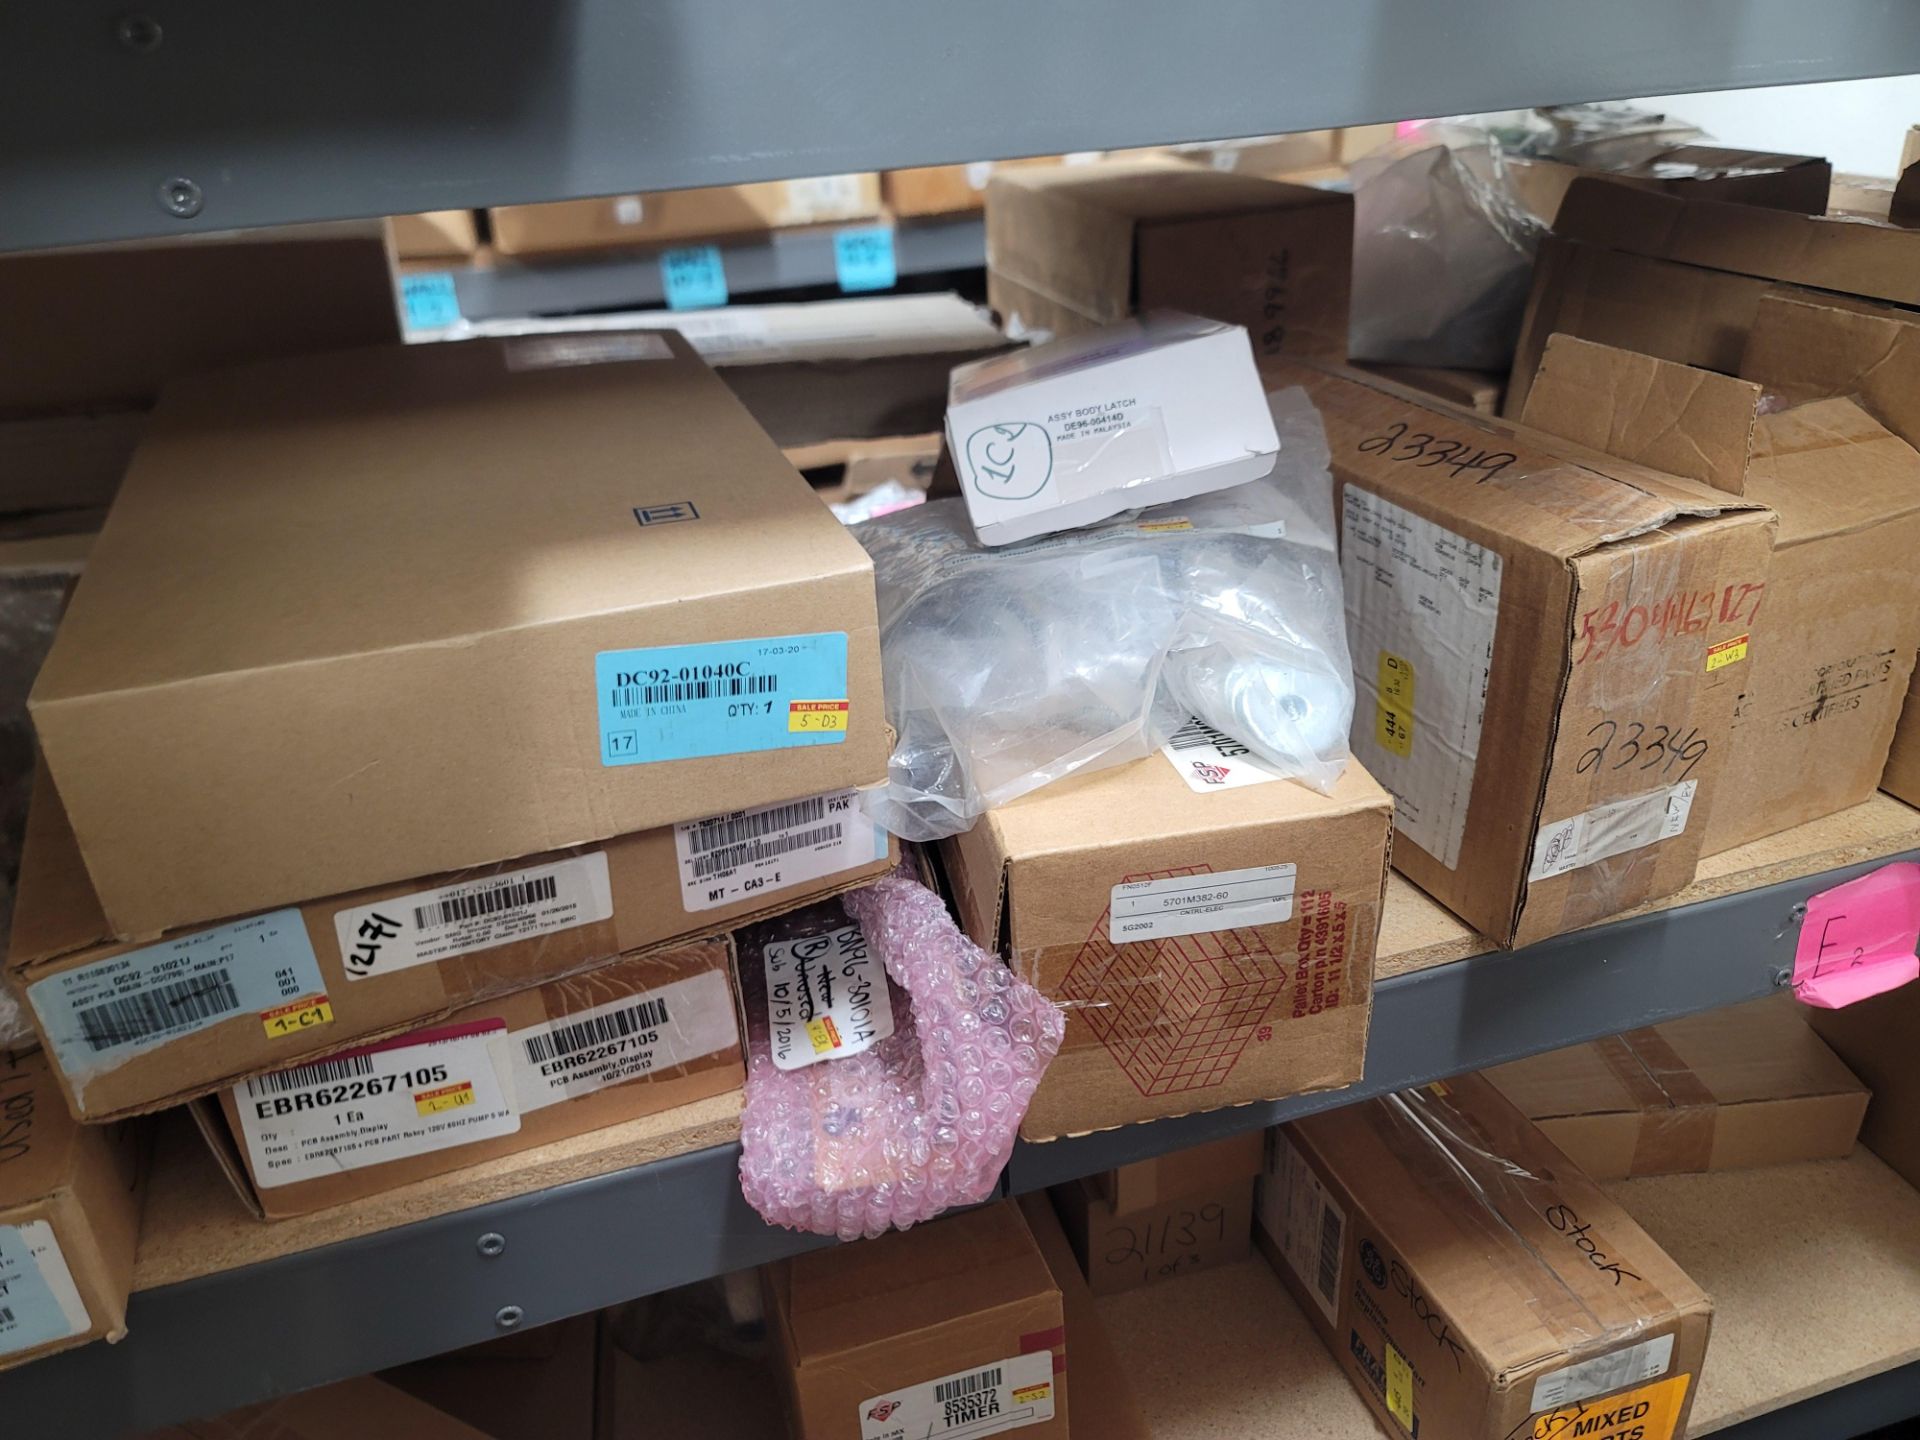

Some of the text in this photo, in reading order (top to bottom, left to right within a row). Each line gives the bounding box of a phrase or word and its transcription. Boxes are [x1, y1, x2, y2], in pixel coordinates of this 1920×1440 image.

[1047, 399, 1136, 423] ASSY BODY LATCH
[1358, 423, 1517, 485] 23349
[616, 661, 751, 687] DC92-01040C
[660, 704, 686, 716] CHINA
[728, 701, 773, 718] Q'TY: 1
[818, 702, 839, 711] PRICE
[611, 736, 633, 751] 17
[1576, 720, 1708, 785] 23349
[829, 799, 850, 814] PAK
[708, 887, 725, 901] MT
[1162, 891, 1229, 907] 5701M382-60
[1301, 889, 1316, 914] 112
[1180, 904, 1224, 916] CNTRL-ELEC
[1332, 922, 1345, 932] 5
[450, 936, 491, 951] INVENTORY
[1297, 927, 1315, 952] Qty
[1309, 890, 1332, 1015] Carton p/n 4391605
[1329, 944, 1344, 966] 1/2
[1296, 953, 1310, 980] Box
[1328, 968, 1341, 983] 11
[1292, 980, 1308, 1019] Pallet
[1325, 988, 1339, 1009] ID:
[274, 1008, 325, 1032] 1-C1
[772, 981, 796, 1060] 10/5/2016
[541, 1030, 659, 1077] EBR62267105
[550, 1075, 570, 1088] PCB
[601, 1061, 652, 1082] 10/21/2013
[255, 1064, 449, 1120] EBR62267105
[334, 1115, 342, 1126] 1
[346, 1110, 364, 1123] Ea
[468, 1113, 490, 1125] PUMP
[301, 1136, 319, 1148] PCB
[1105, 1203, 1224, 1264] 21139
[867, 1401, 902, 1421] FSP
[945, 1388, 998, 1416] 8535372
[944, 1402, 1000, 1428] TIMER
[1573, 1401, 1649, 1438] MIXED
